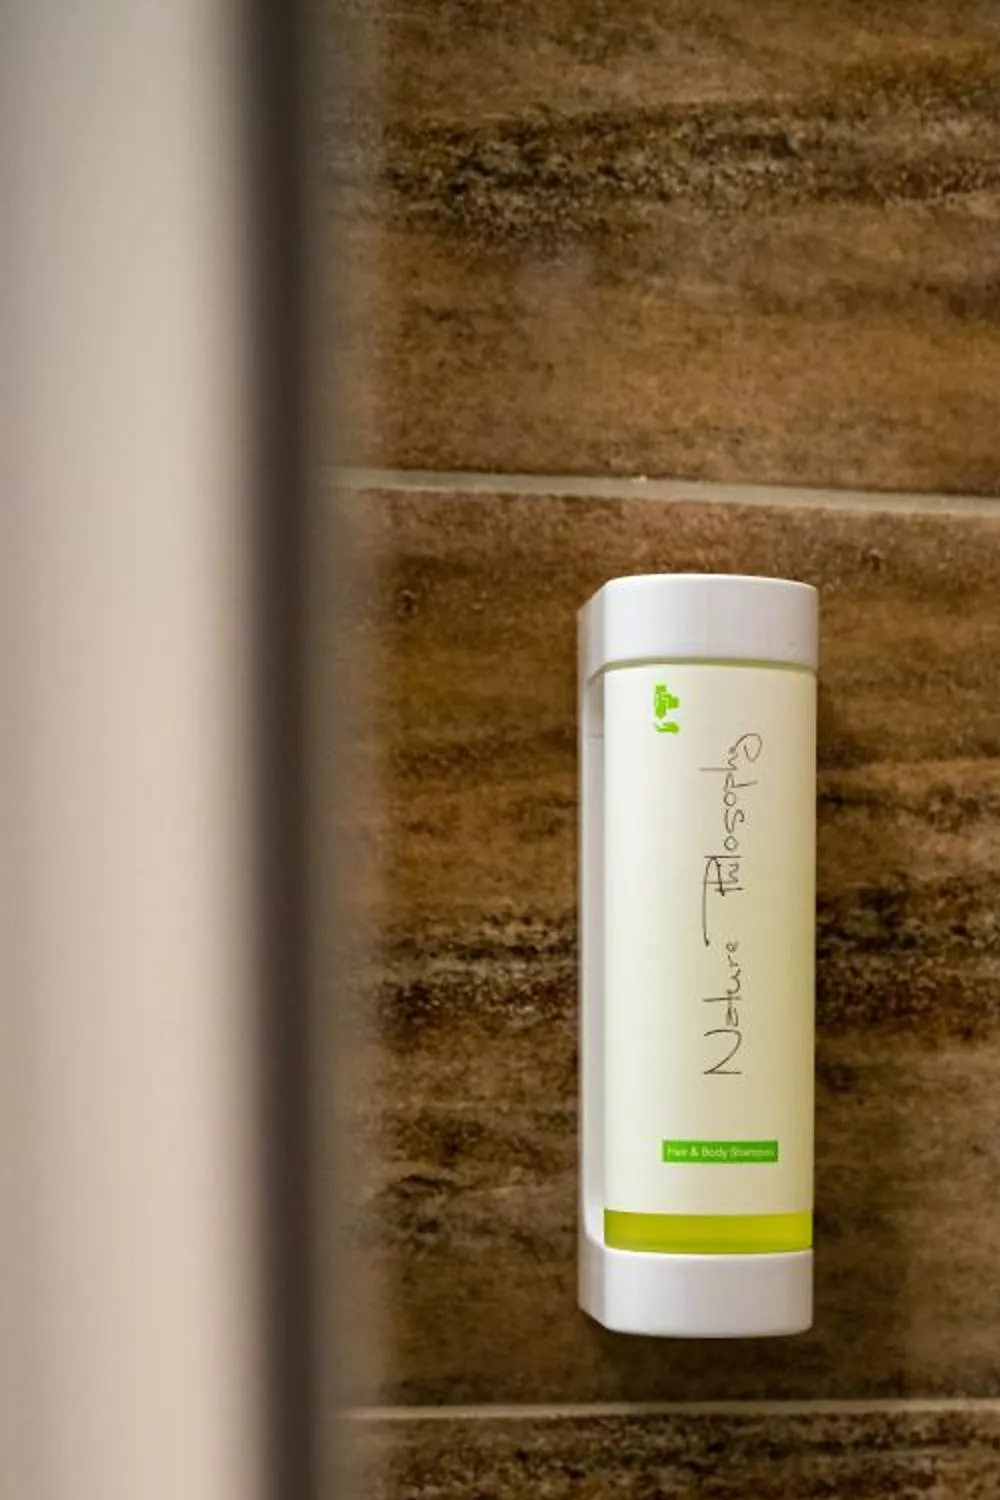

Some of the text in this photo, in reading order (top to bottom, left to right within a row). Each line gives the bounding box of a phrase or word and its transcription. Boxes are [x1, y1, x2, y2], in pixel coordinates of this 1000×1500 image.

[699, 732, 764, 1075] Nature Philosophy
[689, 1144, 699, 1157] &
[701, 1143, 727, 1160] Body
